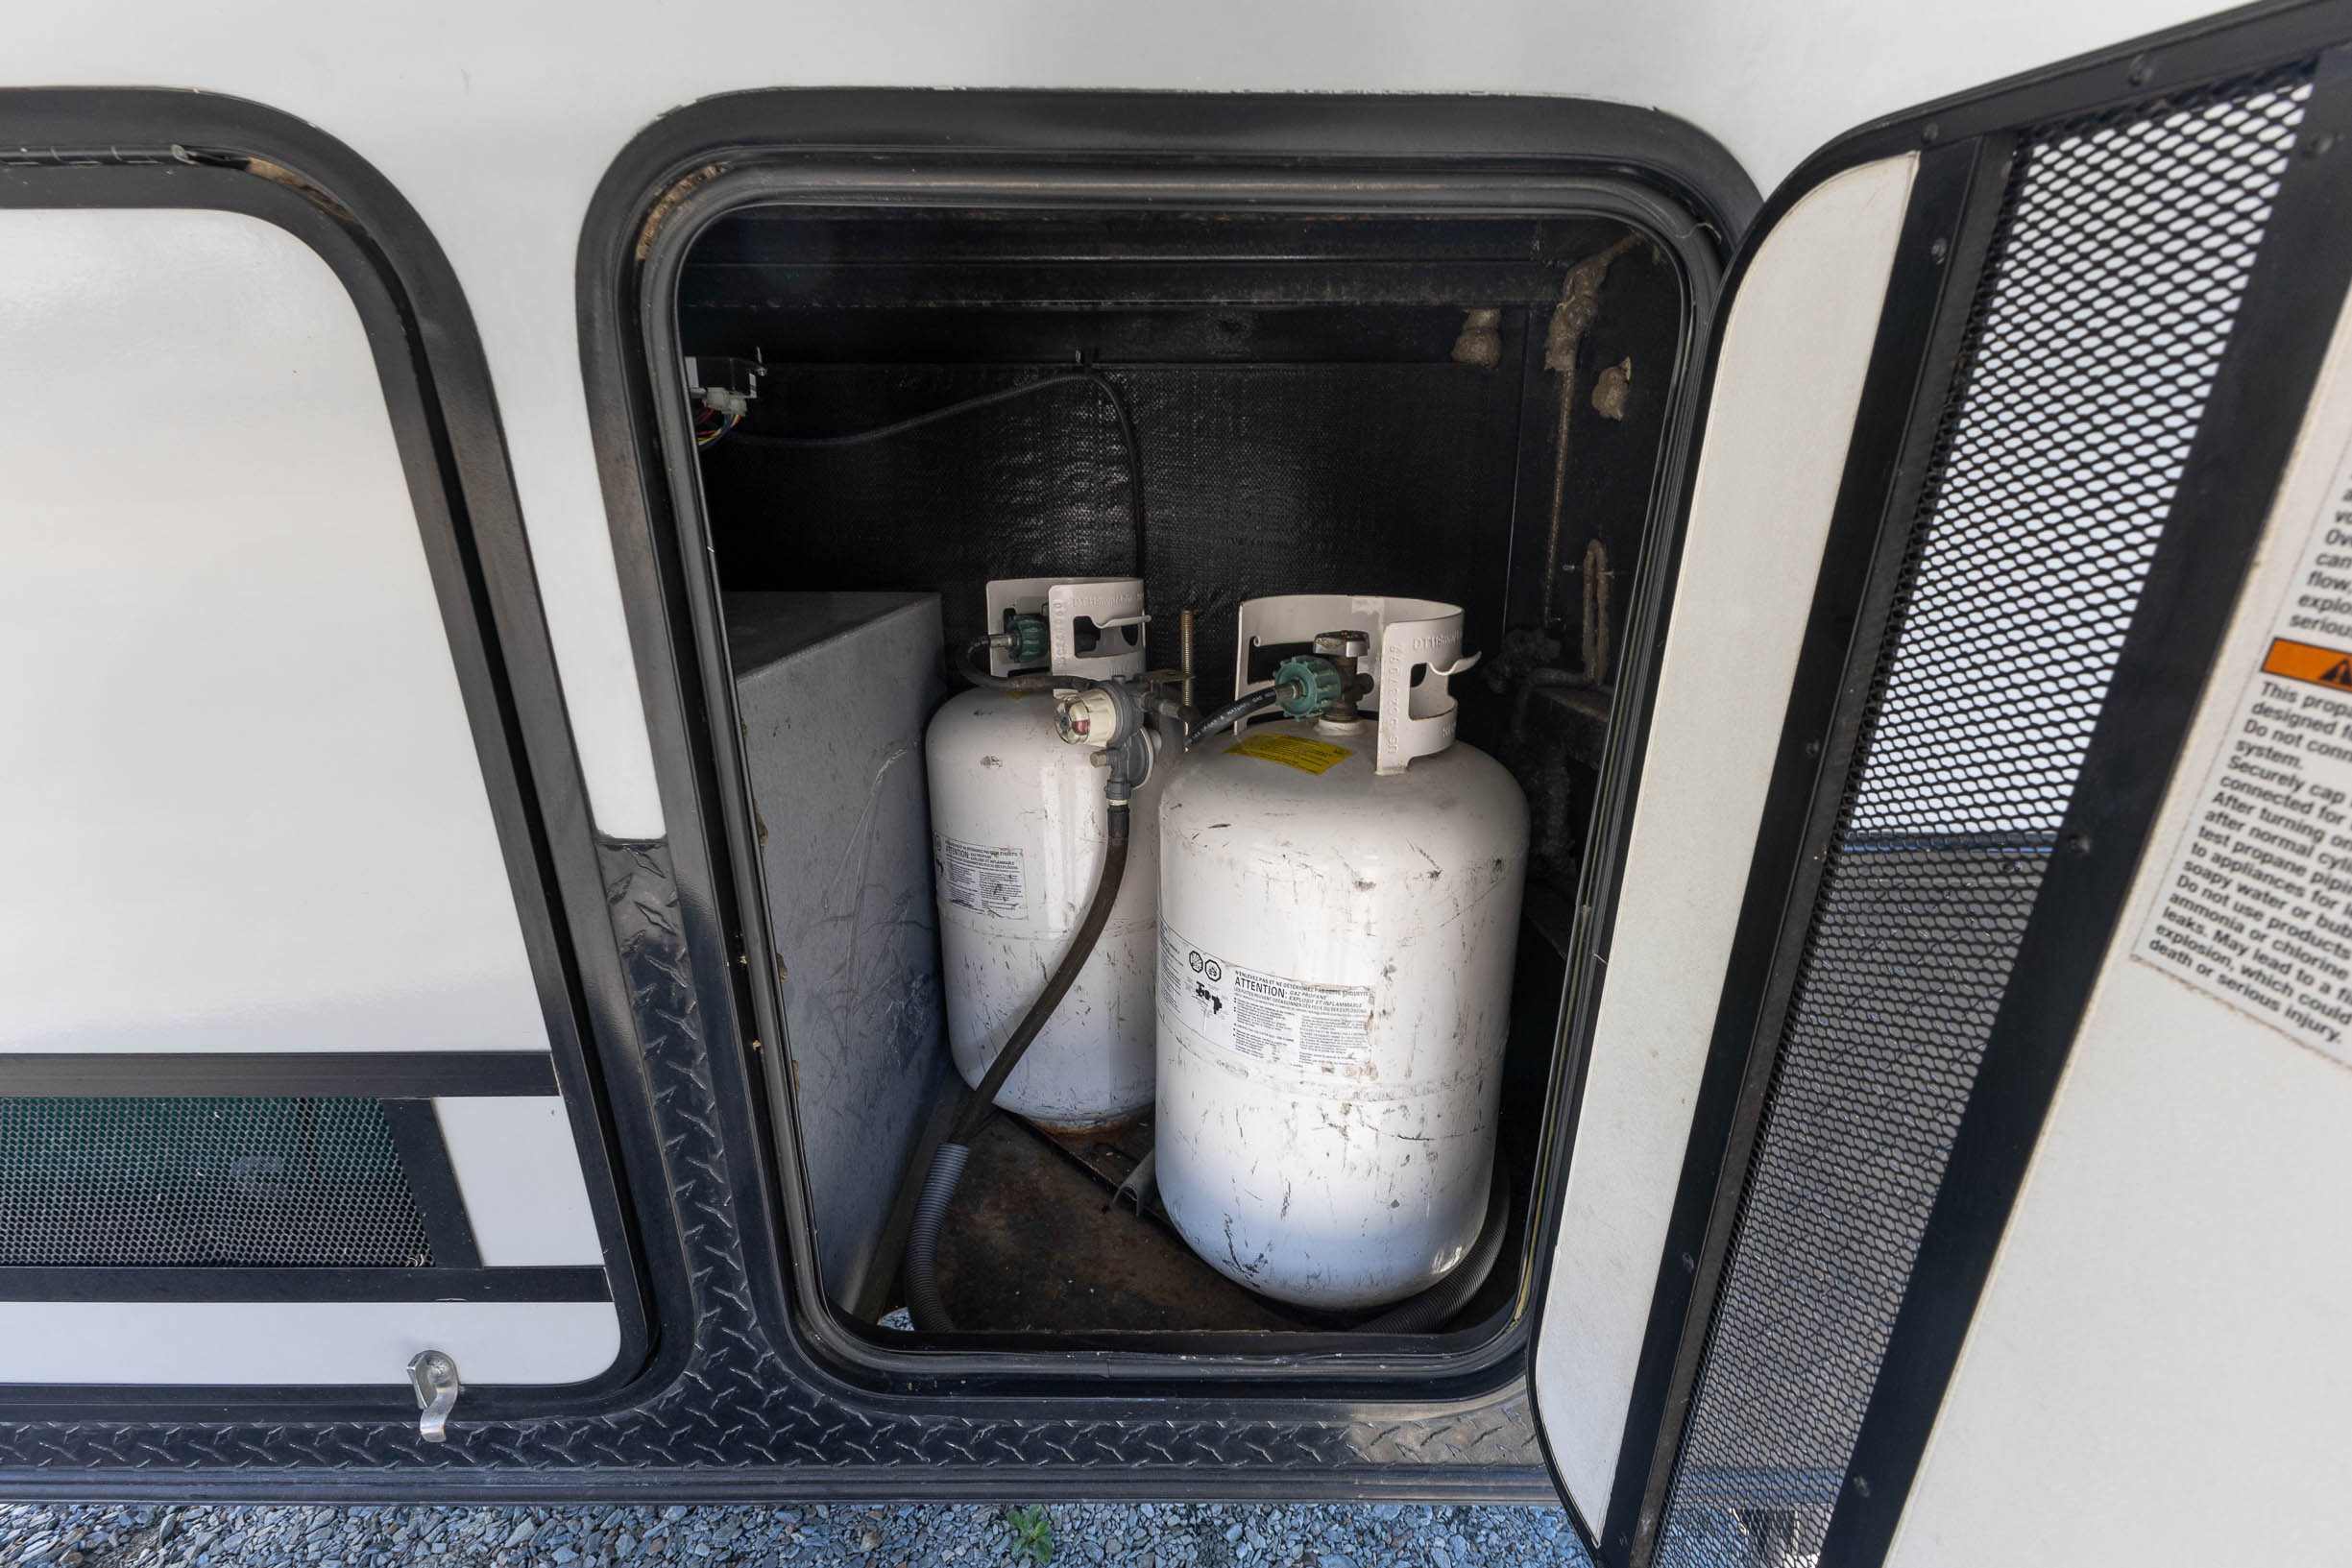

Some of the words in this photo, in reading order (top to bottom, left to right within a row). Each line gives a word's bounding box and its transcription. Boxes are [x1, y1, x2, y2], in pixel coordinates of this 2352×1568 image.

[2314, 551, 2352, 569] can
[2297, 593, 2352, 615] explo
[2260, 681, 2298, 703] This
[2243, 718, 2268, 736] Do
[2271, 730, 2304, 748] not
[2251, 701, 2338, 736] designed
[2227, 755, 2306, 793] Securely
[2309, 783, 2346, 805] cap
[2235, 739, 2304, 770] system.
[2212, 791, 2256, 815] After
[2259, 808, 2326, 843] turning
[2220, 775, 2314, 815] connected
[2317, 805, 2346, 825] for
[2197, 825, 2230, 847] test
[2232, 841, 2306, 877] propane
[2204, 808, 2247, 832] after
[2248, 825, 2314, 858] normal
[2183, 860, 2233, 889] soapy
[2237, 881, 2288, 910] water
[2291, 905, 2312, 921] or
[2191, 842, 2207, 861] to
[2211, 852, 2306, 899] appliances
[2311, 890, 2340, 910] for
[2169, 893, 2244, 934] ammonia
[2249, 928, 2268, 943] or
[2271, 938, 2349, 980] chlorine
[2176, 874, 2198, 894] Do
[2201, 887, 2231, 907] not
[2233, 902, 2264, 922] use
[2267, 916, 2351, 960] products
[2155, 924, 2235, 972] explosion,
[2240, 963, 2295, 998] which
[2297, 993, 2352, 1025] could
[2162, 906, 2207, 937] leaks.
[2212, 929, 2250, 957] May
[2253, 948, 2293, 976] lead
[2295, 969, 2316, 987] to
[2319, 981, 2332, 995] a
[2148, 938, 2194, 969] death
[2196, 961, 2216, 977] or
[2217, 973, 2280, 1012] serious
[2284, 1006, 2342, 1044] injury.
